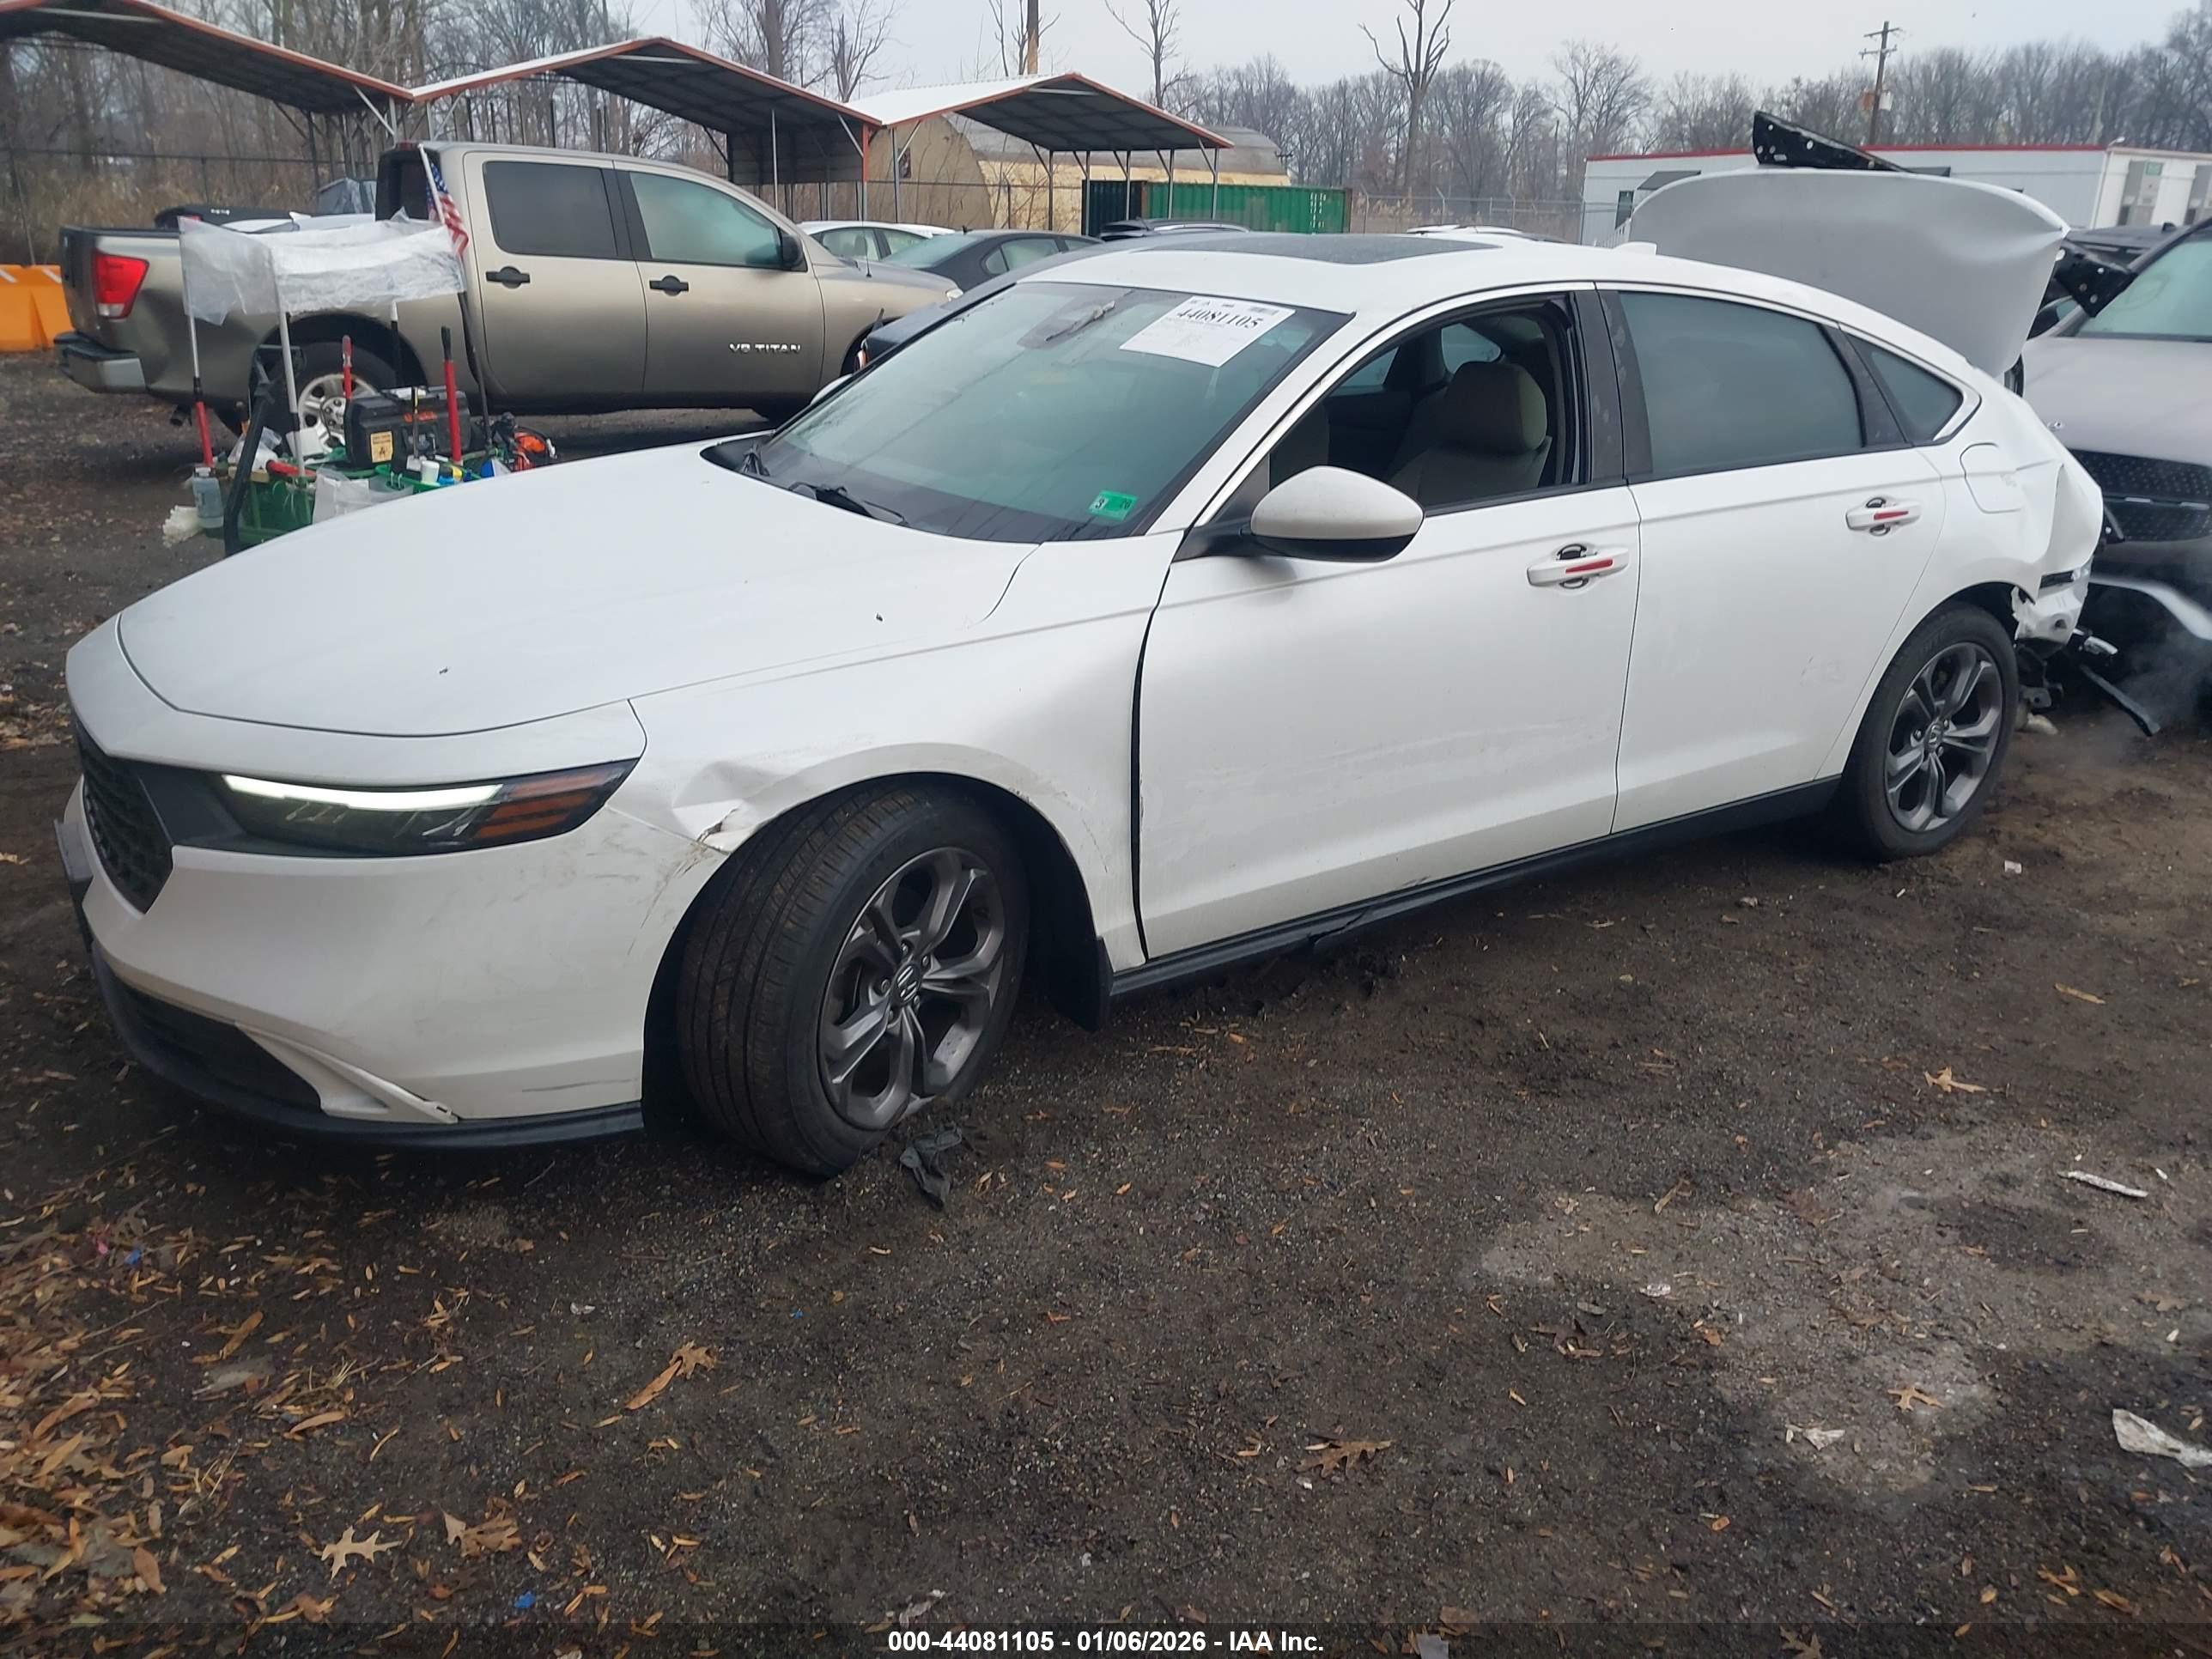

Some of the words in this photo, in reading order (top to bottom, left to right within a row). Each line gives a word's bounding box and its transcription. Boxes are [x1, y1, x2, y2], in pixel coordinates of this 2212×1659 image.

[1177, 308, 1264, 328] 44081105
[755, 343, 800, 353] TITAN
[1095, 499, 1105, 508] 3
